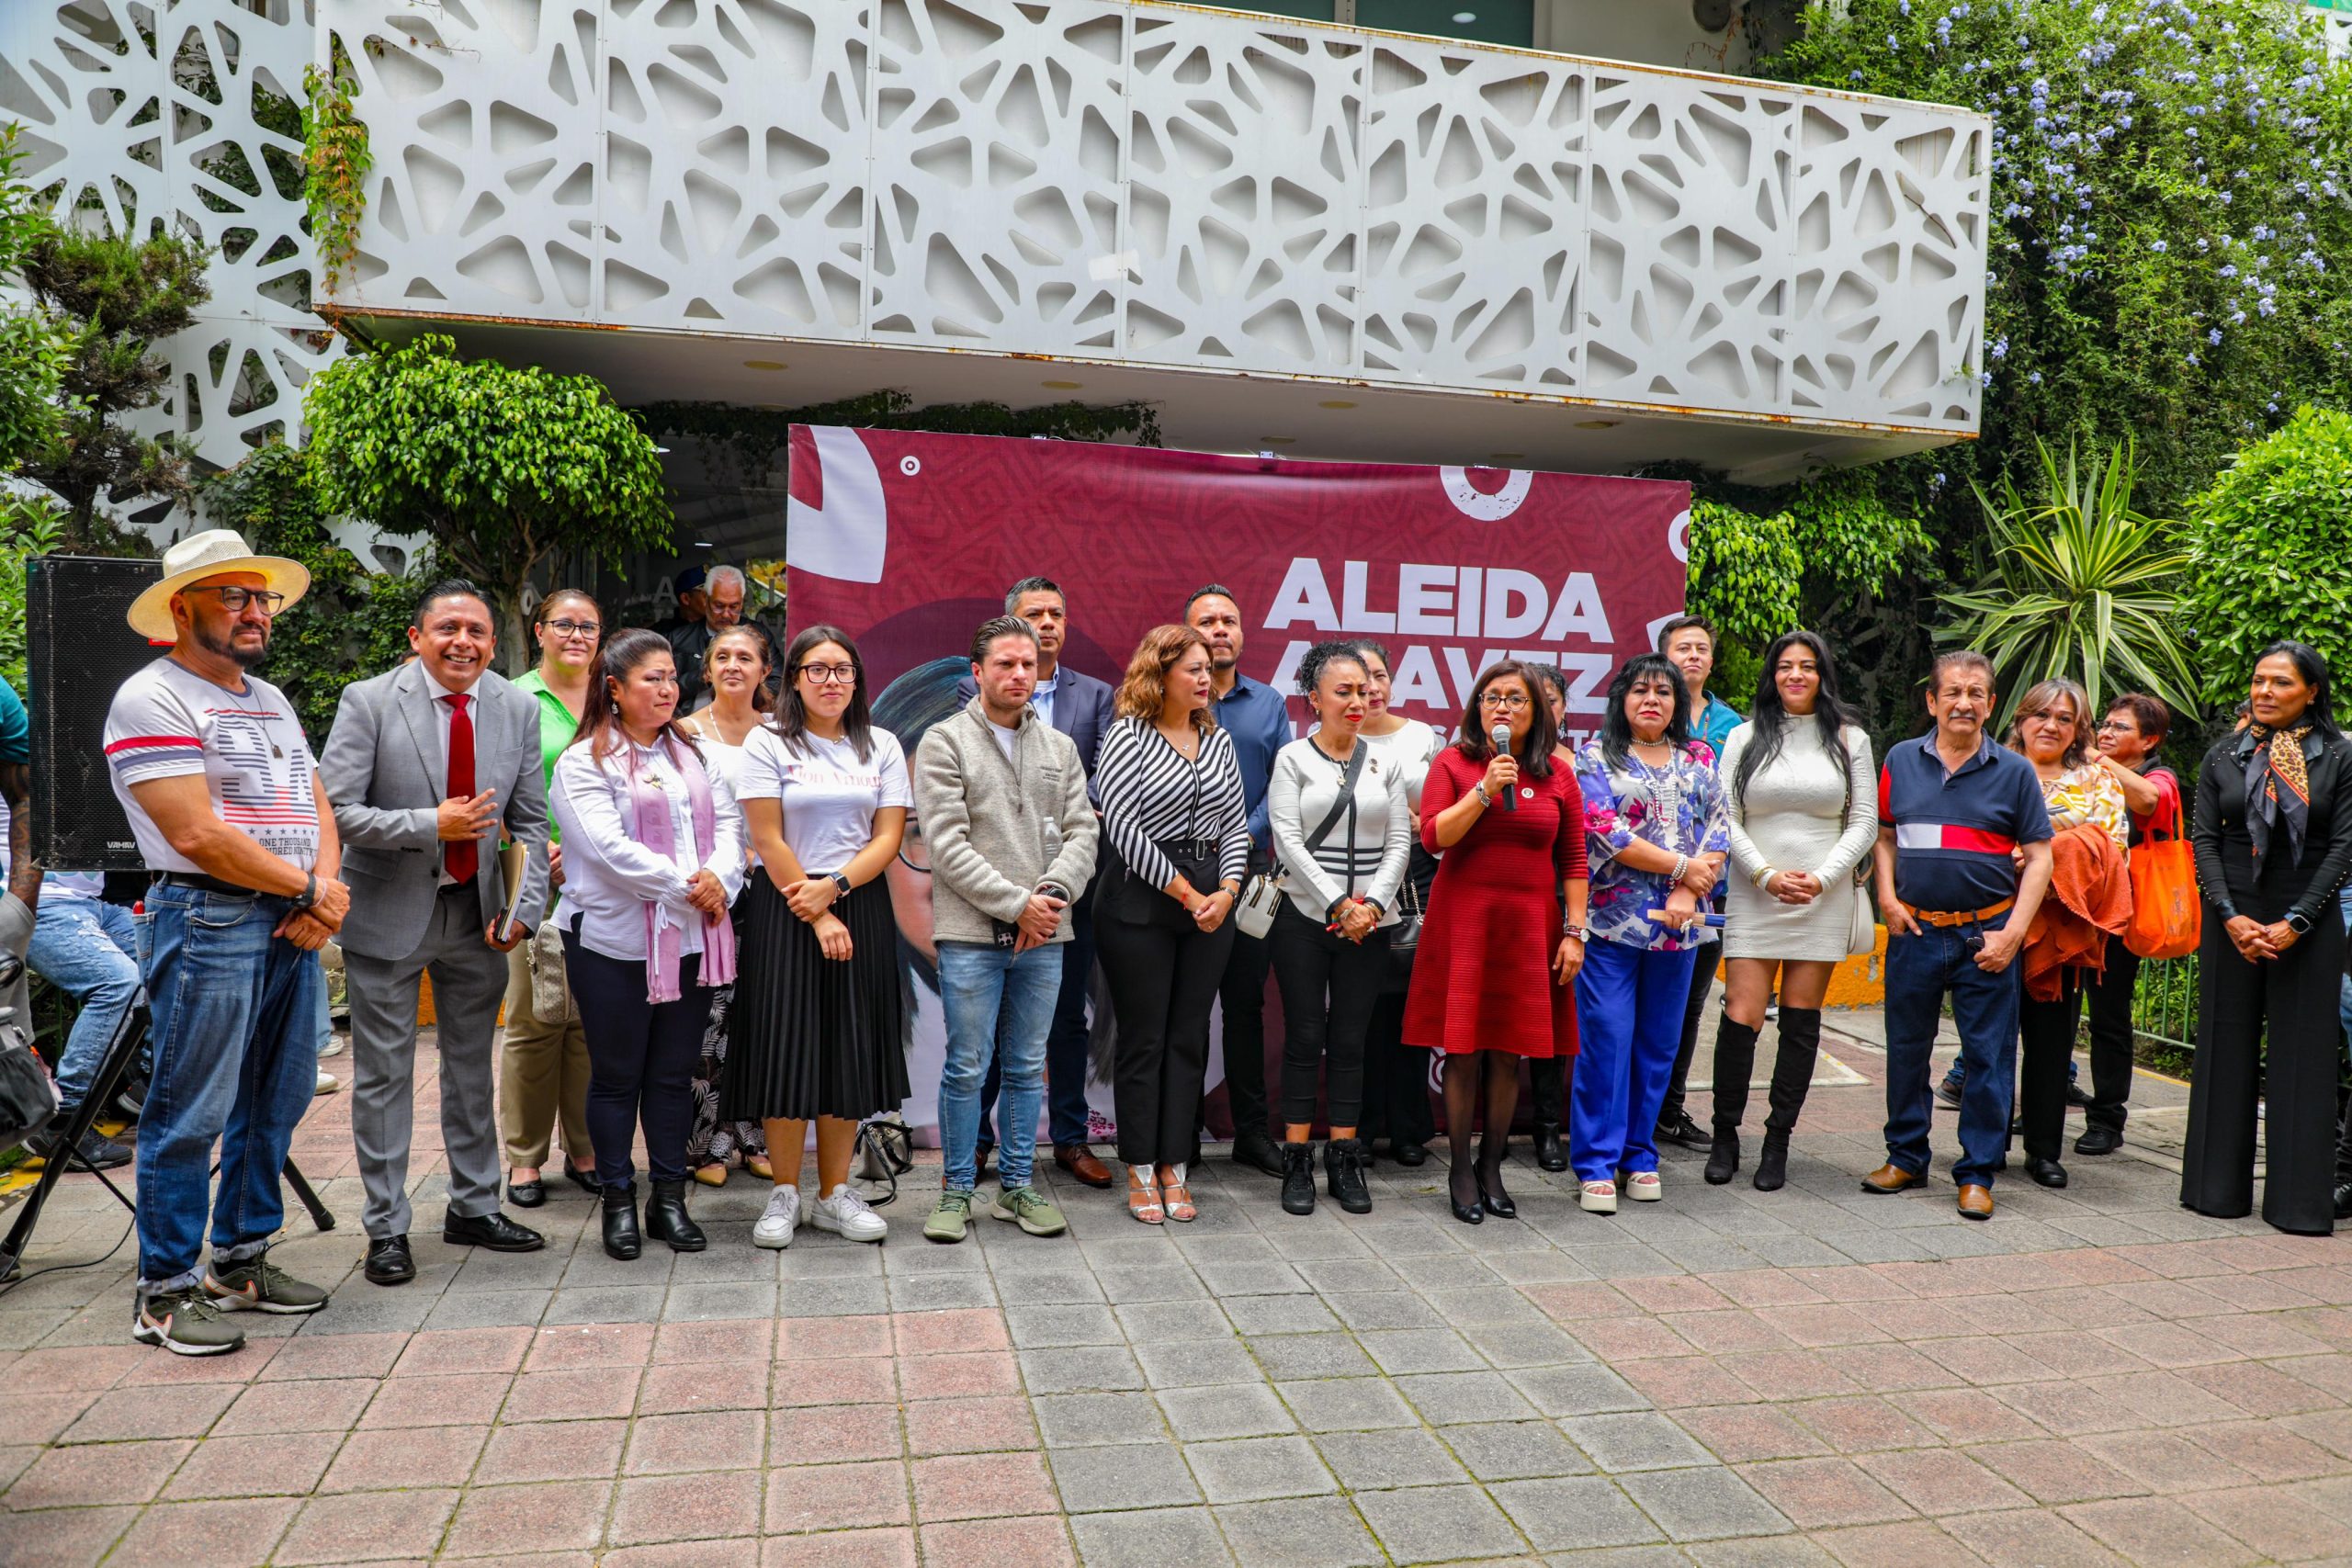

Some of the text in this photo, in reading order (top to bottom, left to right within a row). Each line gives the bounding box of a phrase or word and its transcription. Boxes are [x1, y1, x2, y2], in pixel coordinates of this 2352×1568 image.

[1262, 557, 1614, 643] ALEIDA
[258, 838, 311, 847] ONE THOUSAND
